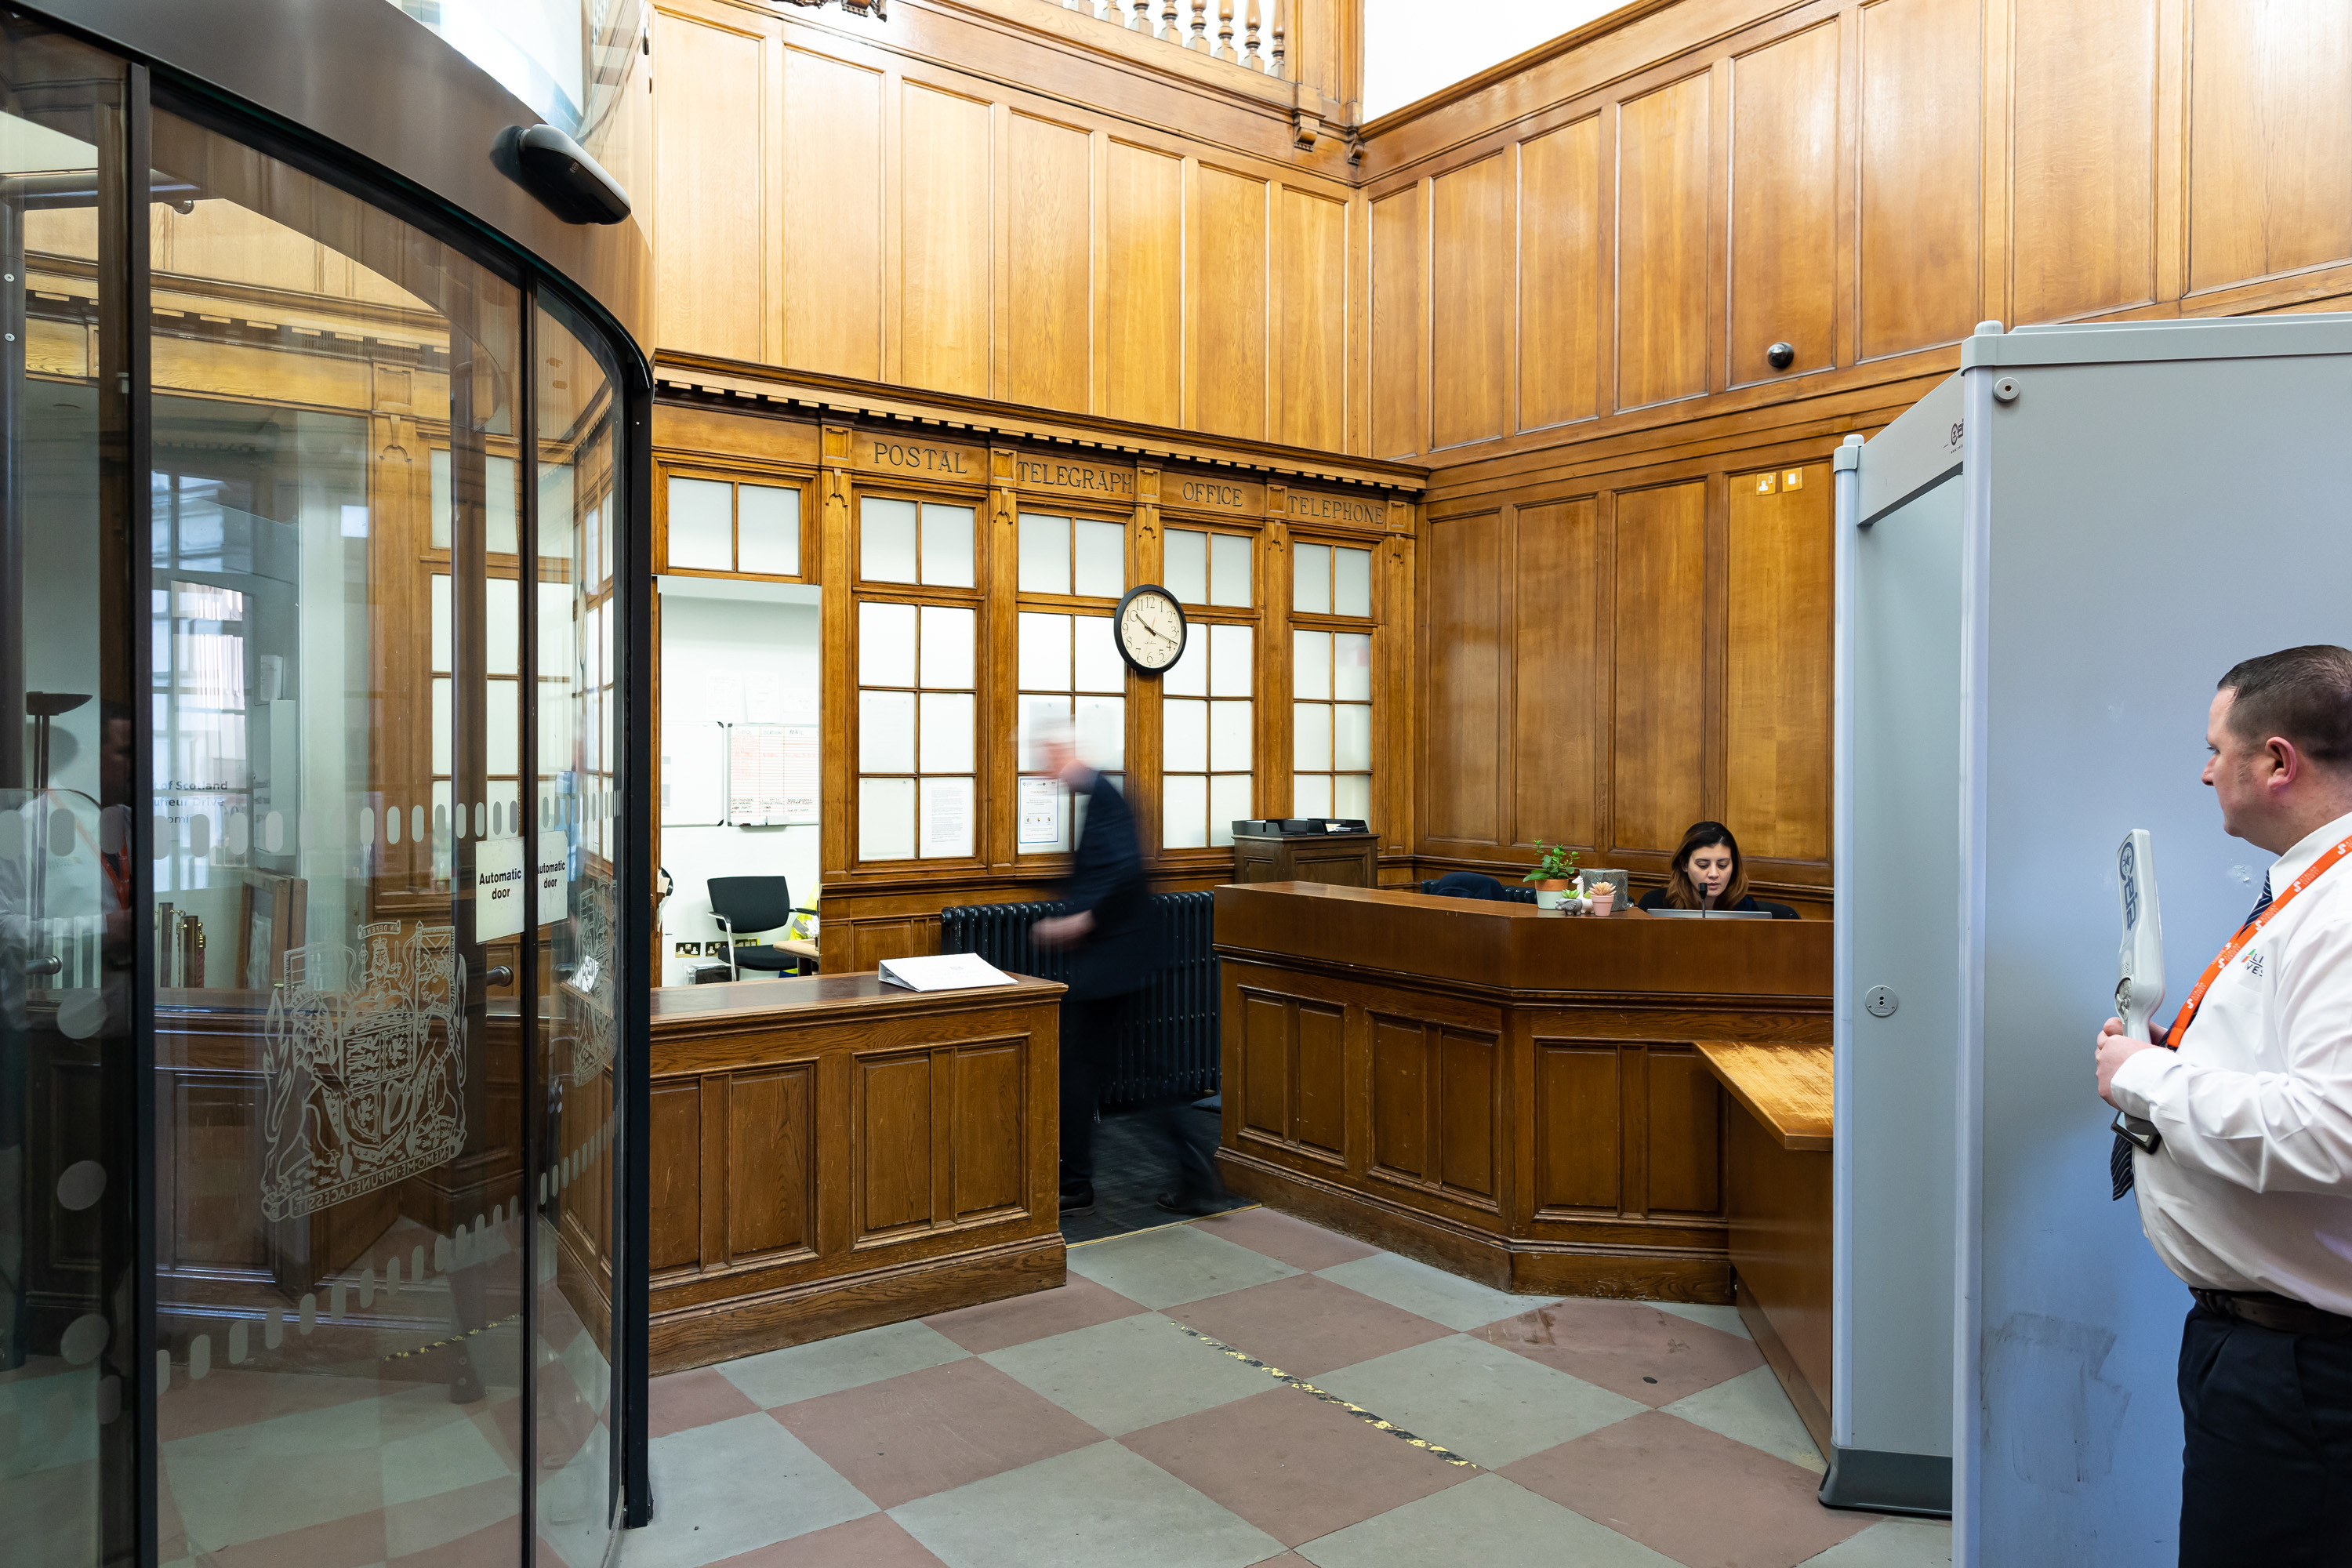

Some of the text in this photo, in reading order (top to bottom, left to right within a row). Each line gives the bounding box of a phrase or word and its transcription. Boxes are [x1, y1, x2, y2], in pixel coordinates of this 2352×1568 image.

[874, 441, 967, 474] POSTAL
[1017, 461, 1133, 494] TELEGRAPH
[1182, 481, 1243, 507] OFFICE
[1287, 495, 1384, 524] TELEPHONE
[1137, 598, 1143, 612] 11
[1145, 596, 1155, 609] 12
[1126, 609, 1138, 622] 10
[1167, 611, 1173, 622] 2
[1122, 622, 1129, 635] 9
[1171, 626, 1178, 638] 3
[1126, 636, 1133, 649] 8
[1167, 640, 1172, 652] 4
[1135, 648, 1142, 660] 7
[1147, 652, 1153, 664] 6
[1159, 649, 1165, 662] 5
[176, 780, 228, 790] Scotland
[479, 868, 521, 885] Automatic
[543, 877, 557, 889] door
[492, 888, 510, 900] door
